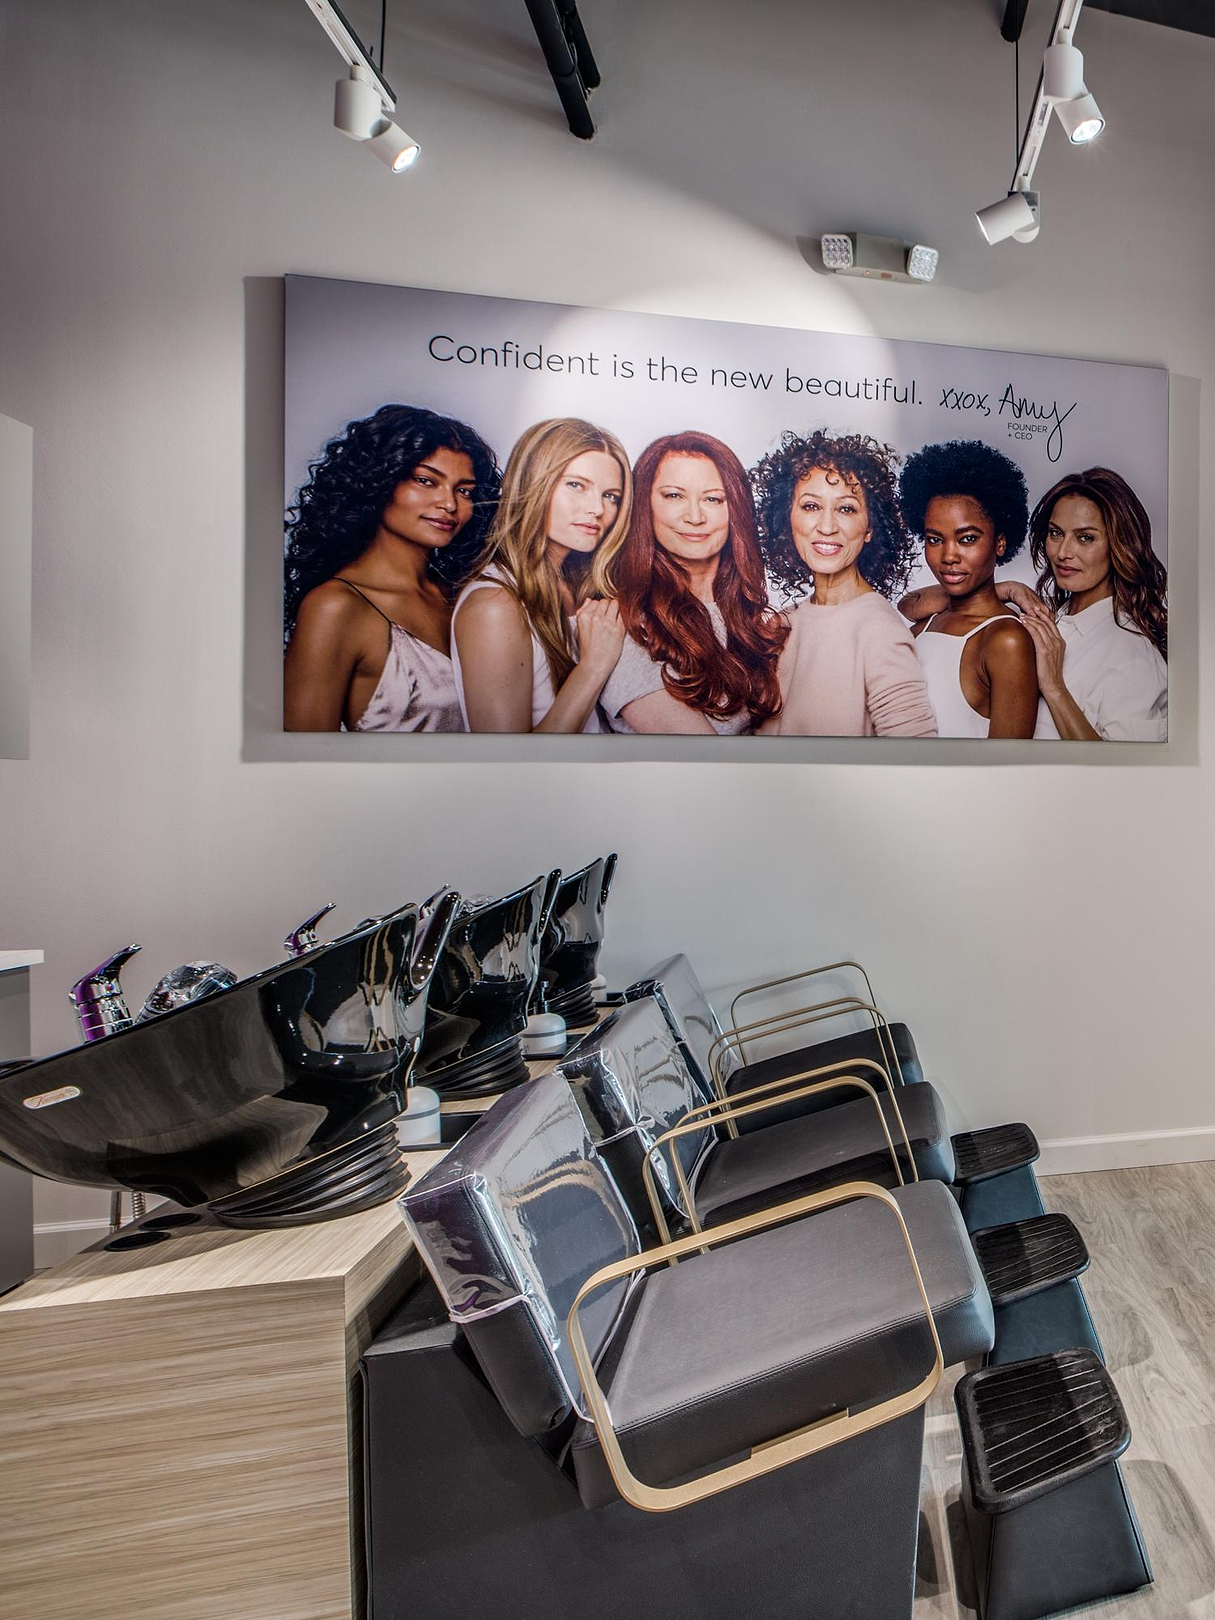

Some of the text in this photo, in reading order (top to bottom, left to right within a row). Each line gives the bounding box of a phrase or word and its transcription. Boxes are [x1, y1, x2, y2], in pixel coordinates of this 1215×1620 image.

[428, 335, 923, 405] Confident is the new beautiful.
[998, 383, 1078, 462] Amy
[1007, 422, 1048, 433] FOUNDER
[1014, 432, 1033, 441] CEO
